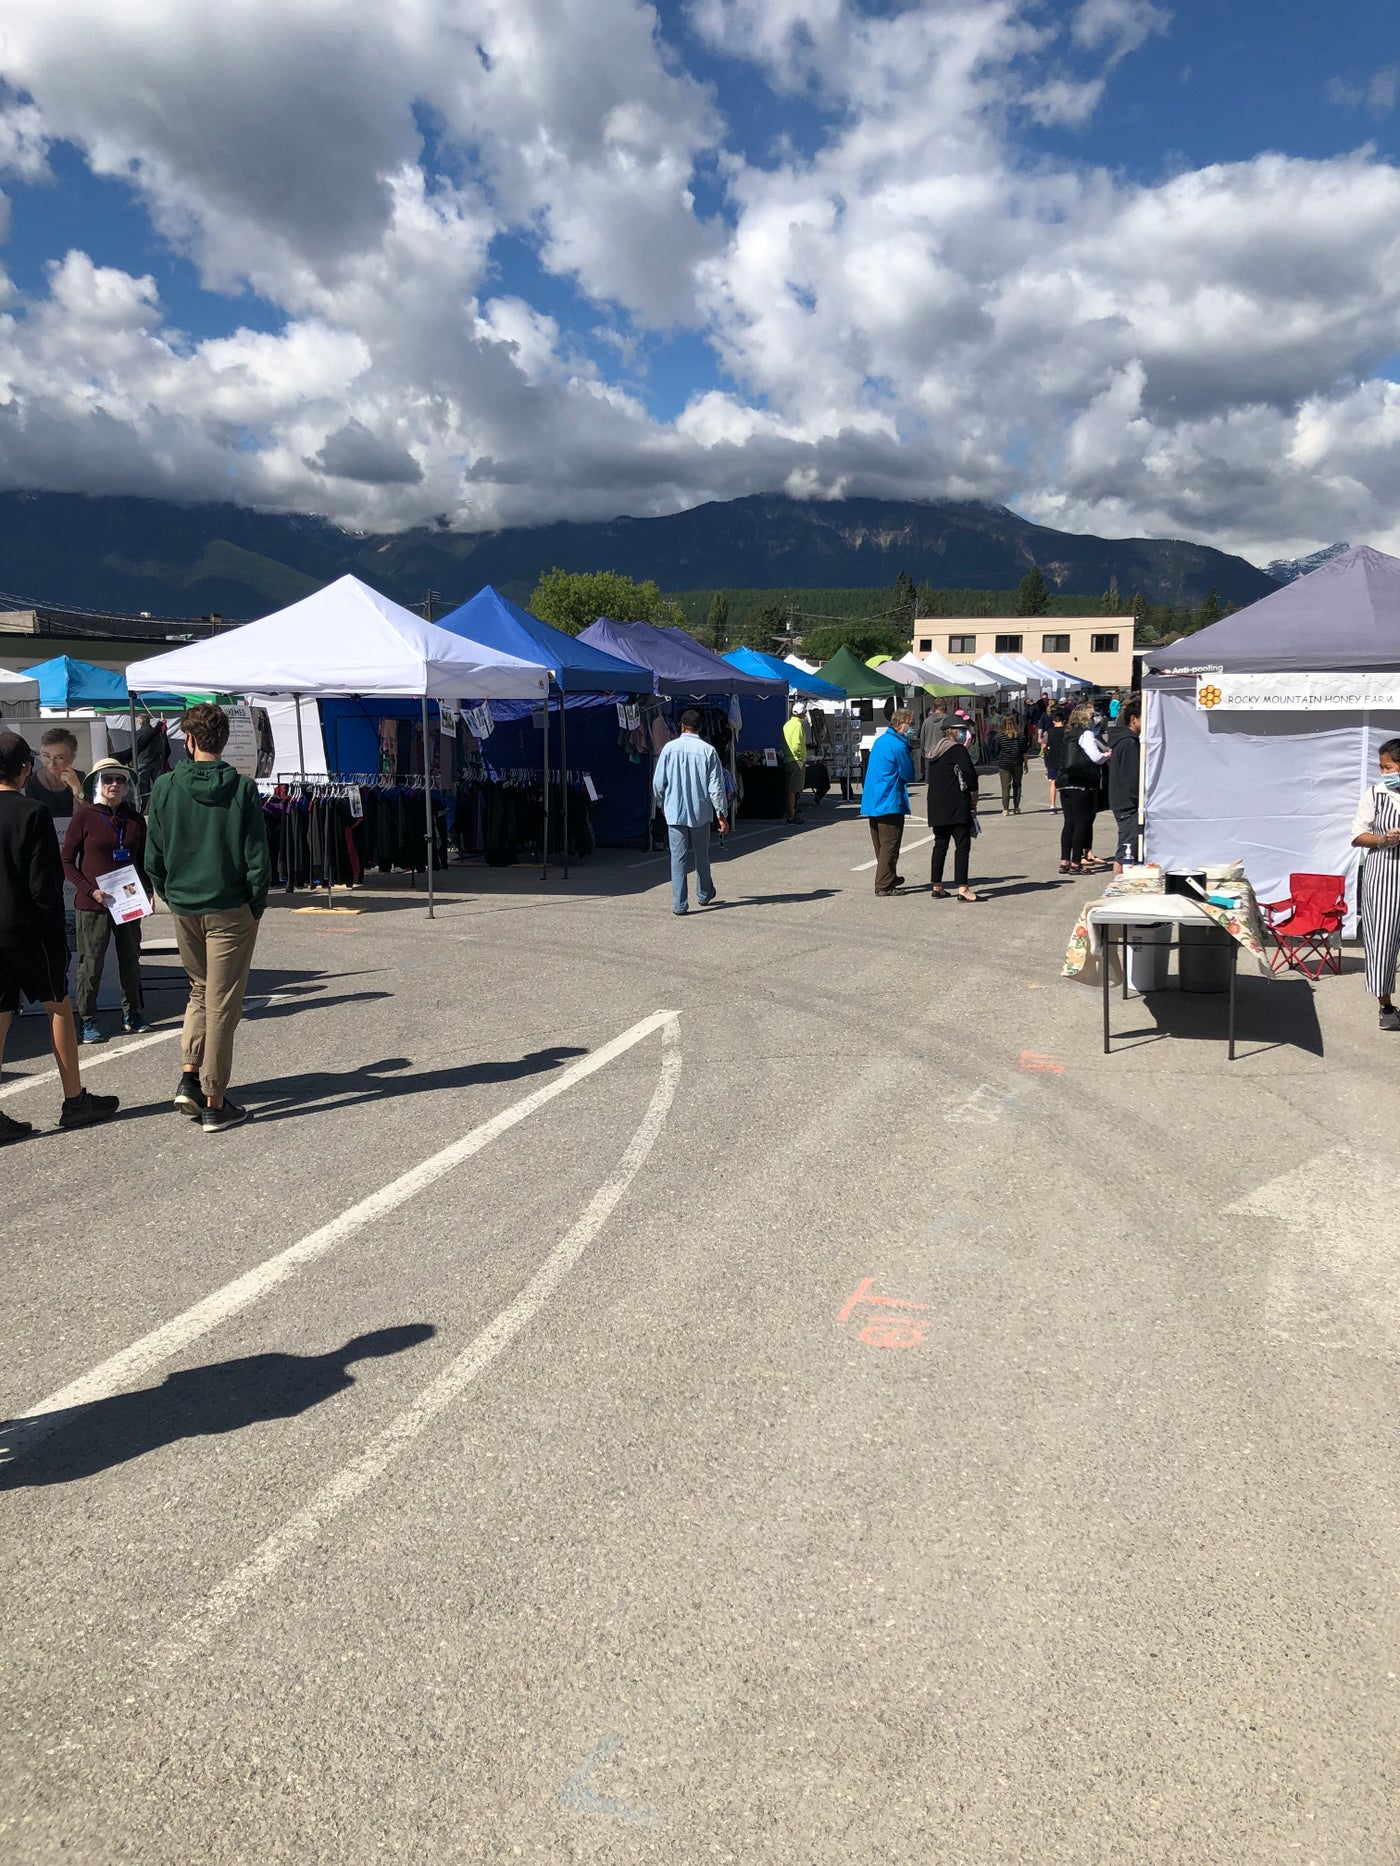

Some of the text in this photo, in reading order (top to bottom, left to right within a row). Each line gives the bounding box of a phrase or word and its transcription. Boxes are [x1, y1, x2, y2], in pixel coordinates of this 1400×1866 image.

[1228, 694, 1395, 705] ROCKY MOUNTAIN HONEY FARM
